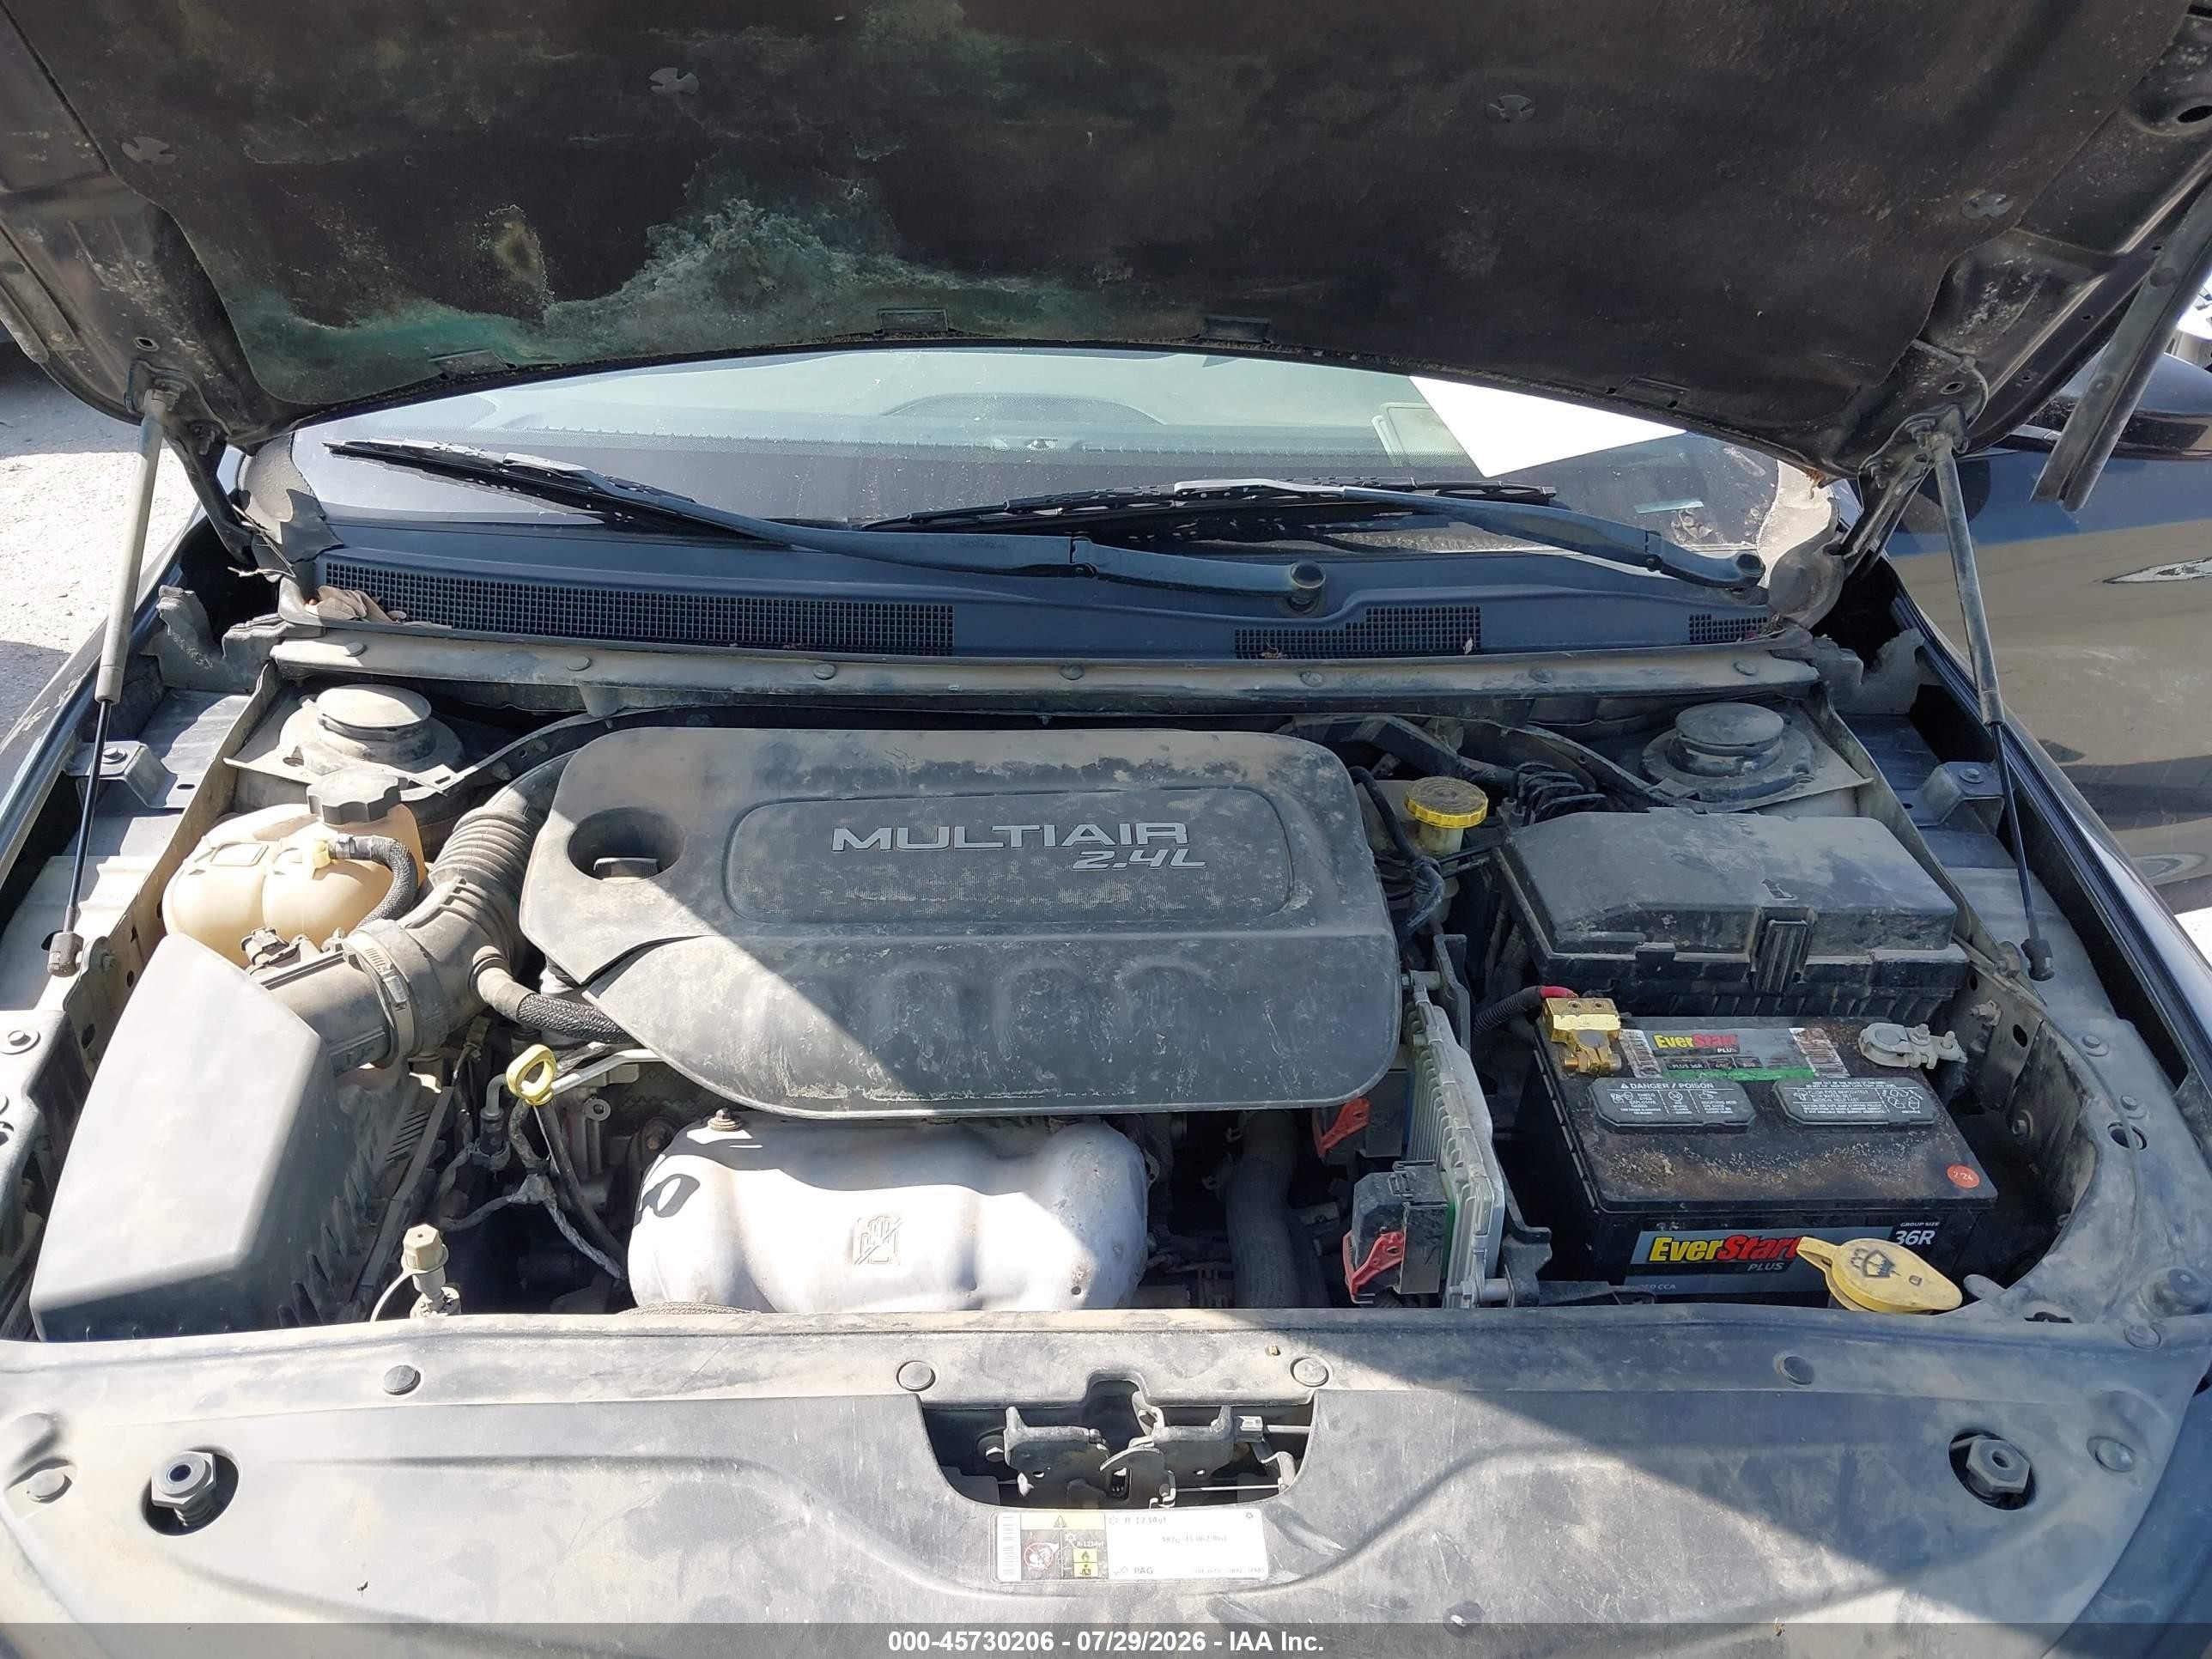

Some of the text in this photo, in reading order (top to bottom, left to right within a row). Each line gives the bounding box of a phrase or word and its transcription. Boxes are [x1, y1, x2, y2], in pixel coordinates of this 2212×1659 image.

[831, 822, 1188, 852] MULTIAIR
[1073, 848, 1206, 871] 2.4L
[1653, 1033, 1738, 1049] EverStart
[1895, 1230, 1936, 1245] 36R
[1648, 1234, 1802, 1261] EverStart
[1747, 1262, 1785, 1272] PLUS
[1133, 1566, 1154, 1575] PAG
